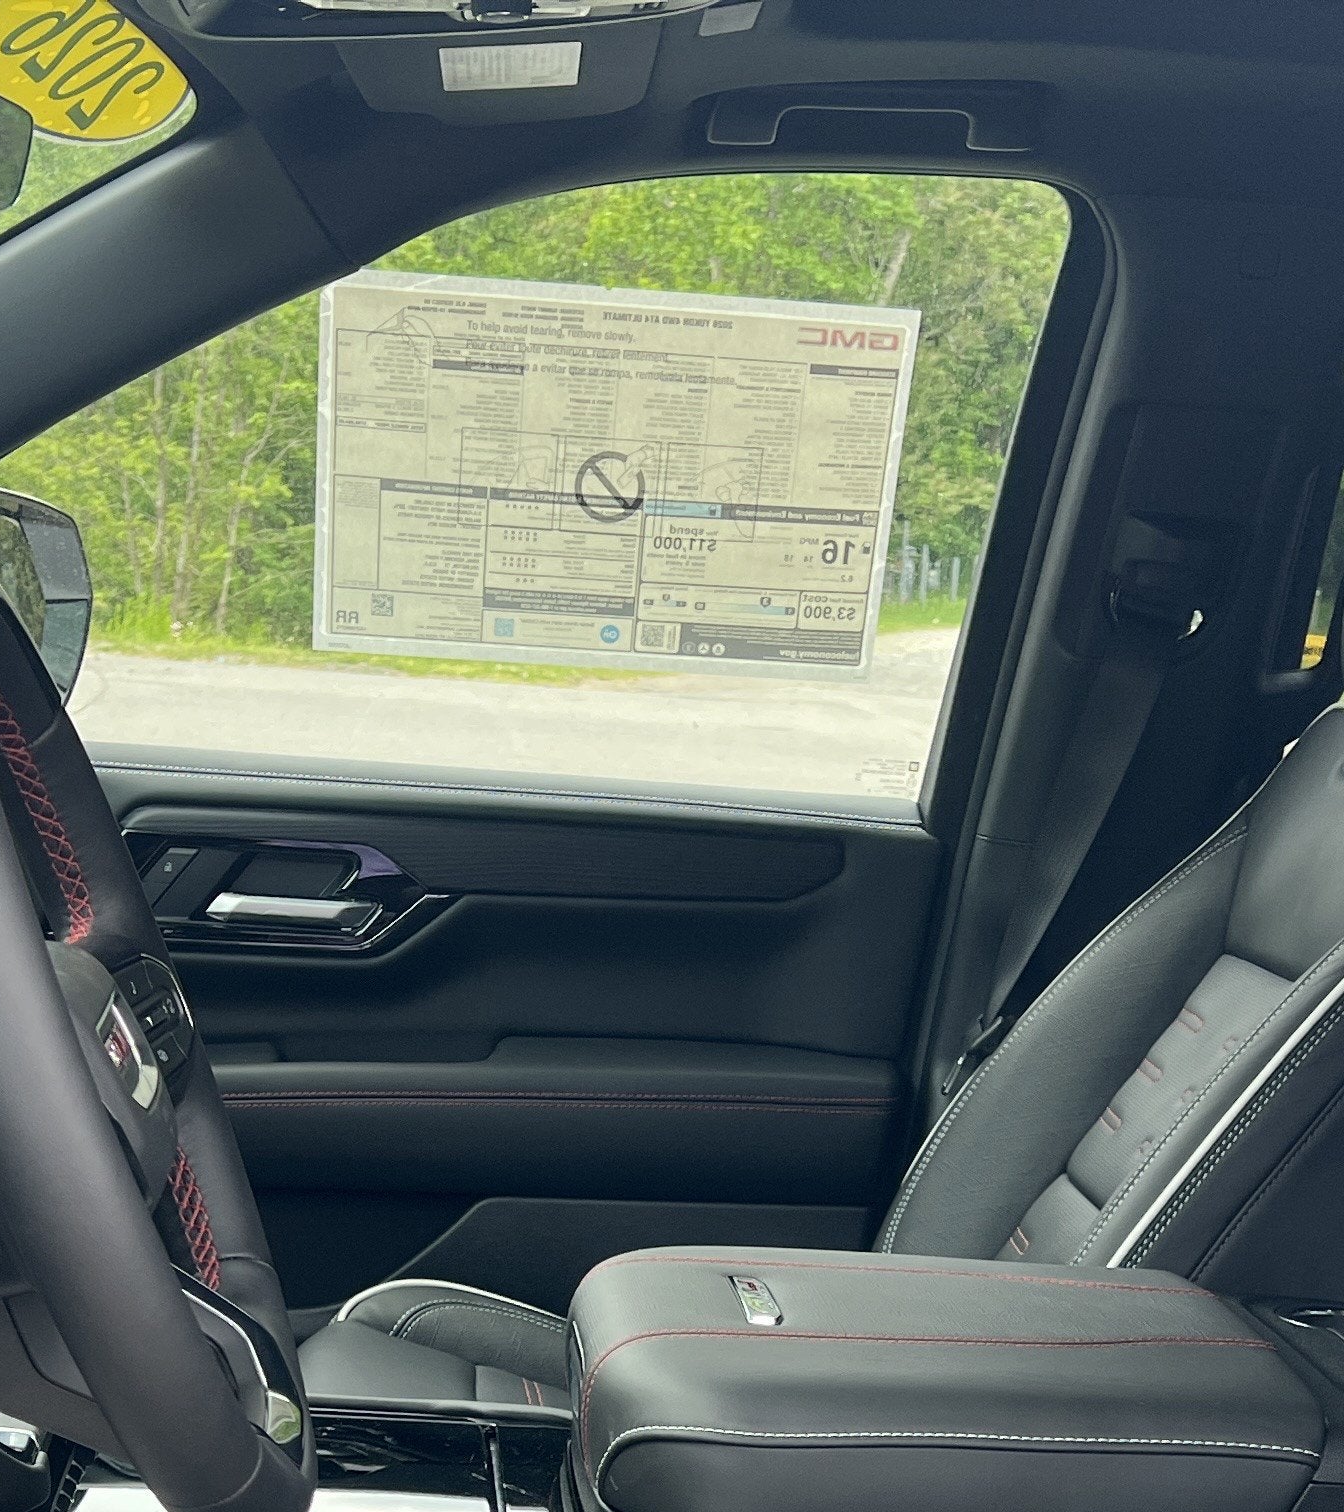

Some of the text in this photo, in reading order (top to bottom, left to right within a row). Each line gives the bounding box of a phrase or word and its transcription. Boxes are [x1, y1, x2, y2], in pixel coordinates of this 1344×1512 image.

[467, 320, 478, 331] To
[480, 322, 500, 334] help
[503, 323, 528, 335] avoid
[568, 329, 602, 340] remove
